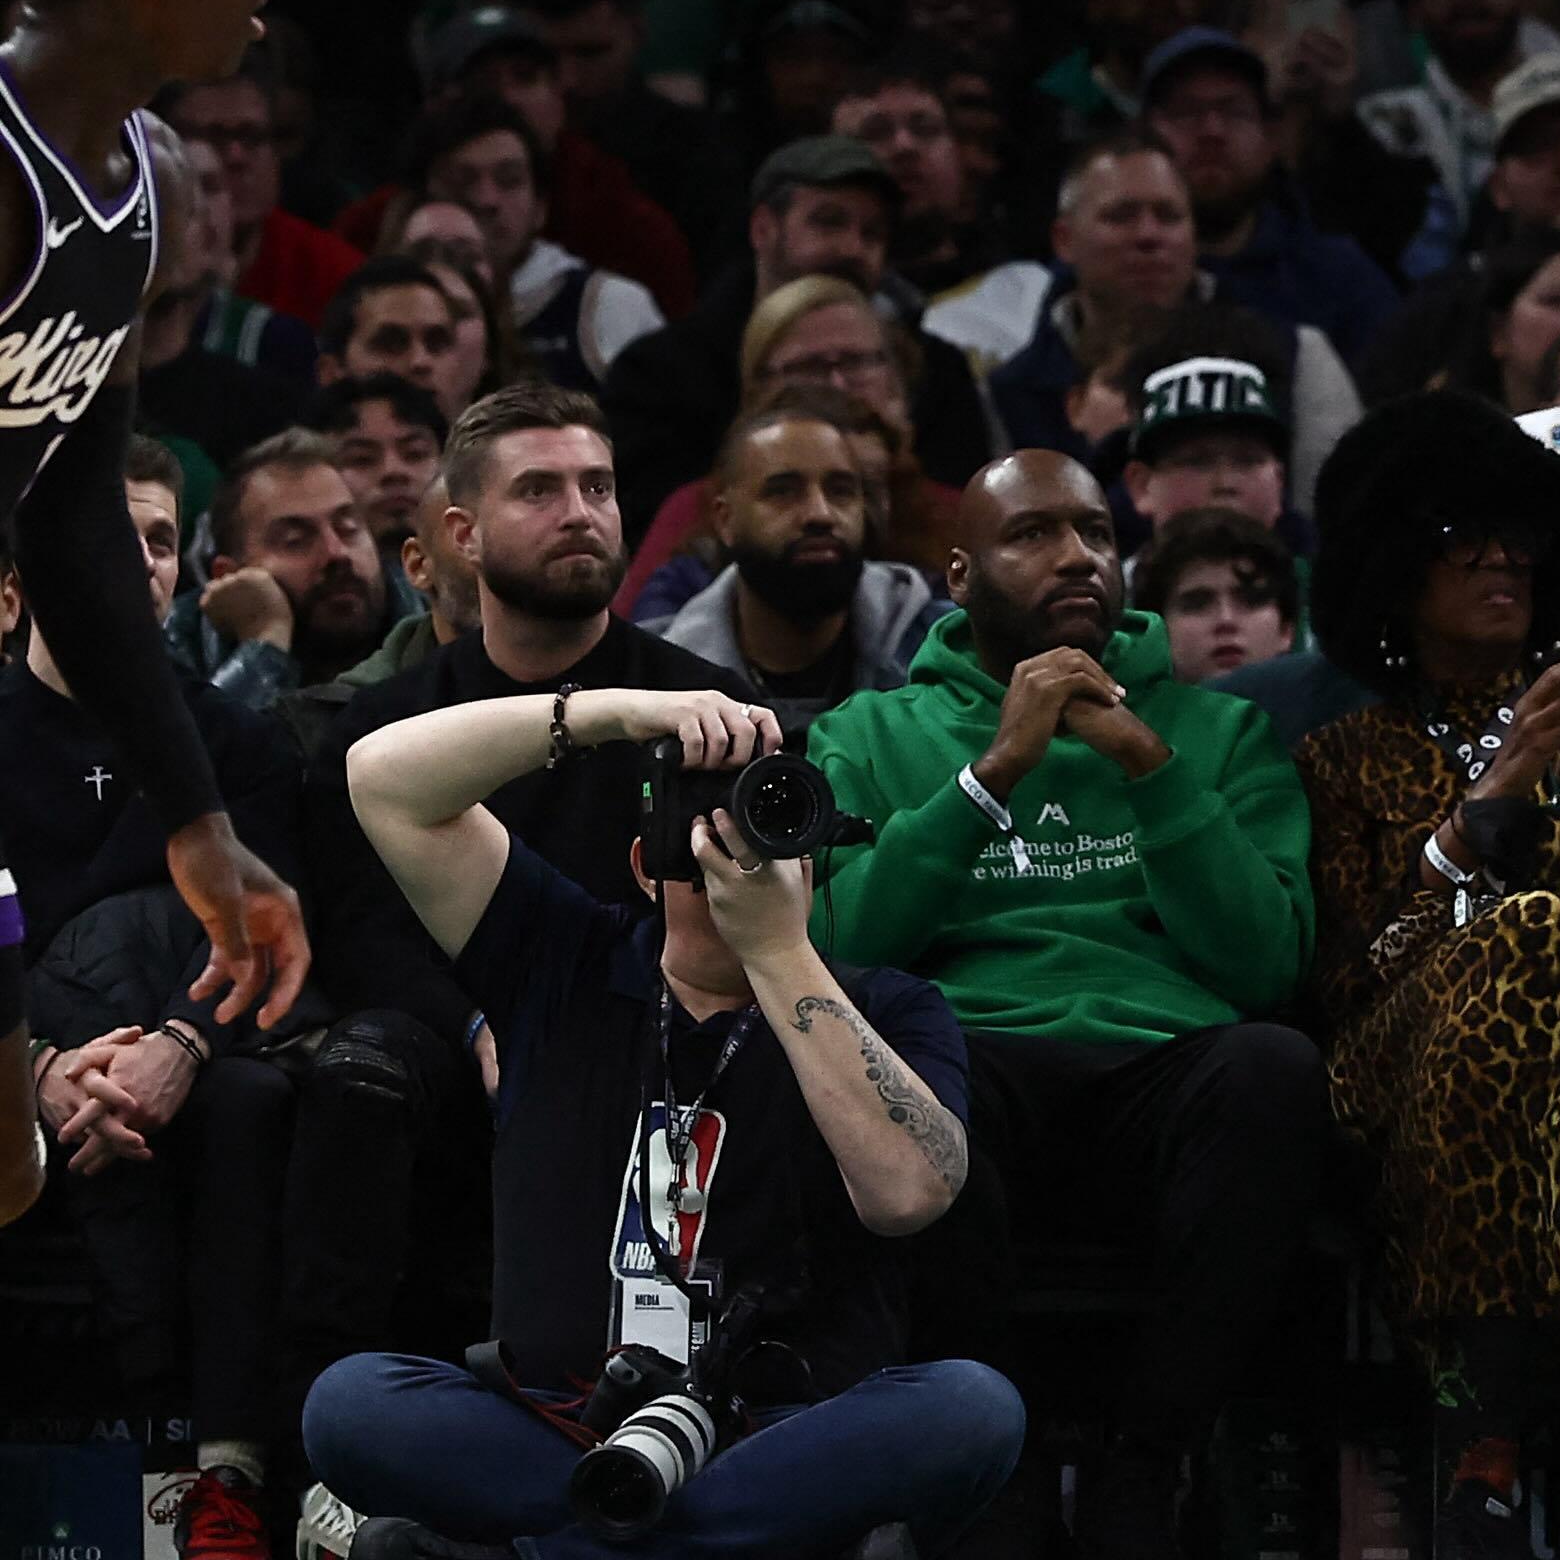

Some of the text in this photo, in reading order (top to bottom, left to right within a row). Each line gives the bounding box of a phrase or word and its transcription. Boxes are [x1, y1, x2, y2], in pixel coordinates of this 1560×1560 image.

[0, 309, 130, 428] King
[1054, 842, 1075, 856] to
[1077, 832, 1133, 853] Bosto
[991, 860, 1075, 880] wining
[1076, 856, 1093, 874] is
[1097, 846, 1140, 870] trad
[635, 1294, 660, 1307] MEDIA
